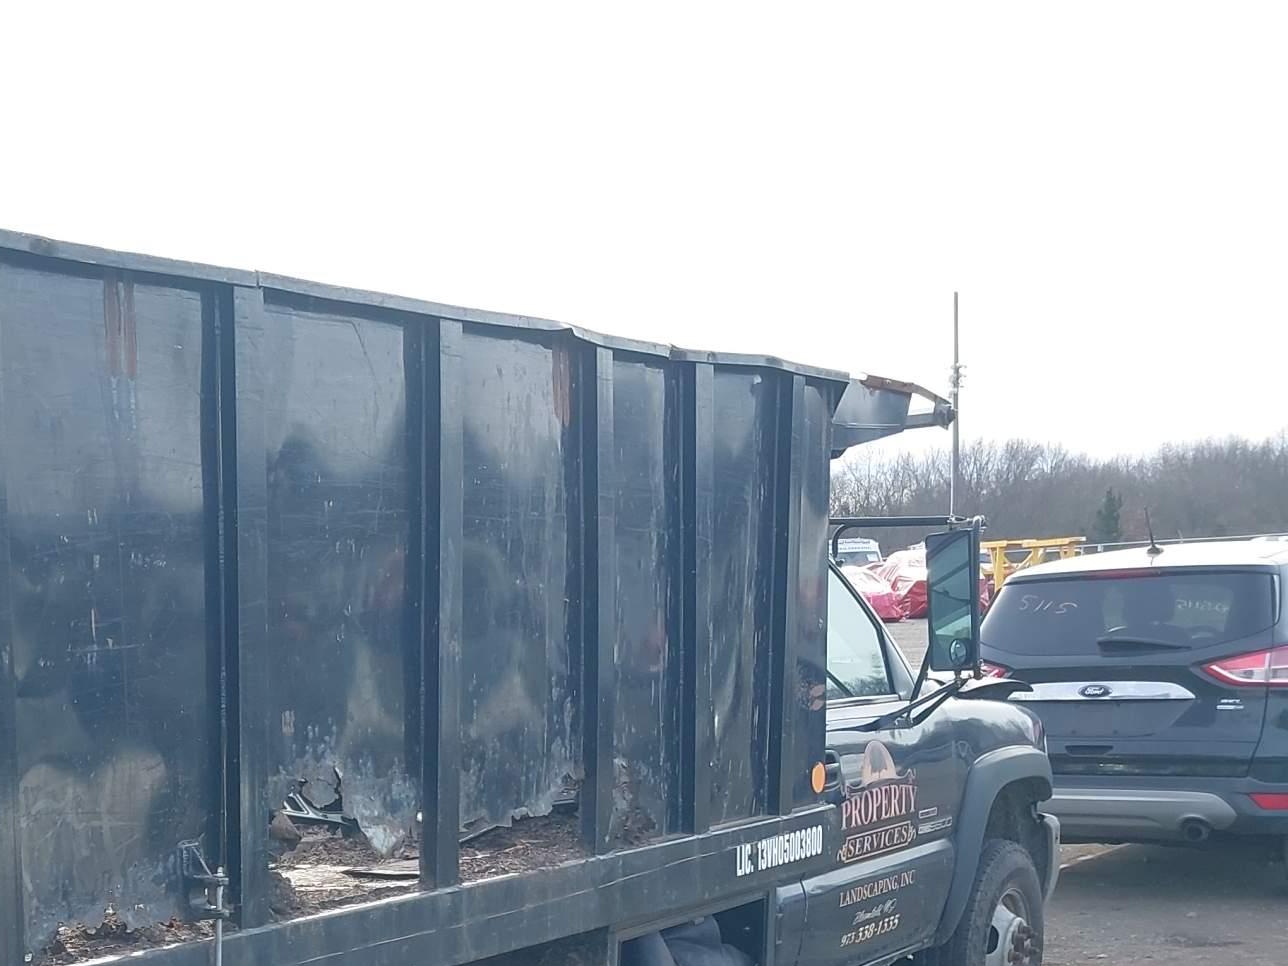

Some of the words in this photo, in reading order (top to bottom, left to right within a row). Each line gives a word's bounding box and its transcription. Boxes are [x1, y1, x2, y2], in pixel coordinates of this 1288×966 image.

[841, 784, 917, 831] PROPERTY
[736, 844, 754, 877] LIC.
[757, 824, 823, 871] 13VH05003800
[847, 825, 908, 858] SERVICES
[839, 875, 900, 908] LANDSCAPING,
